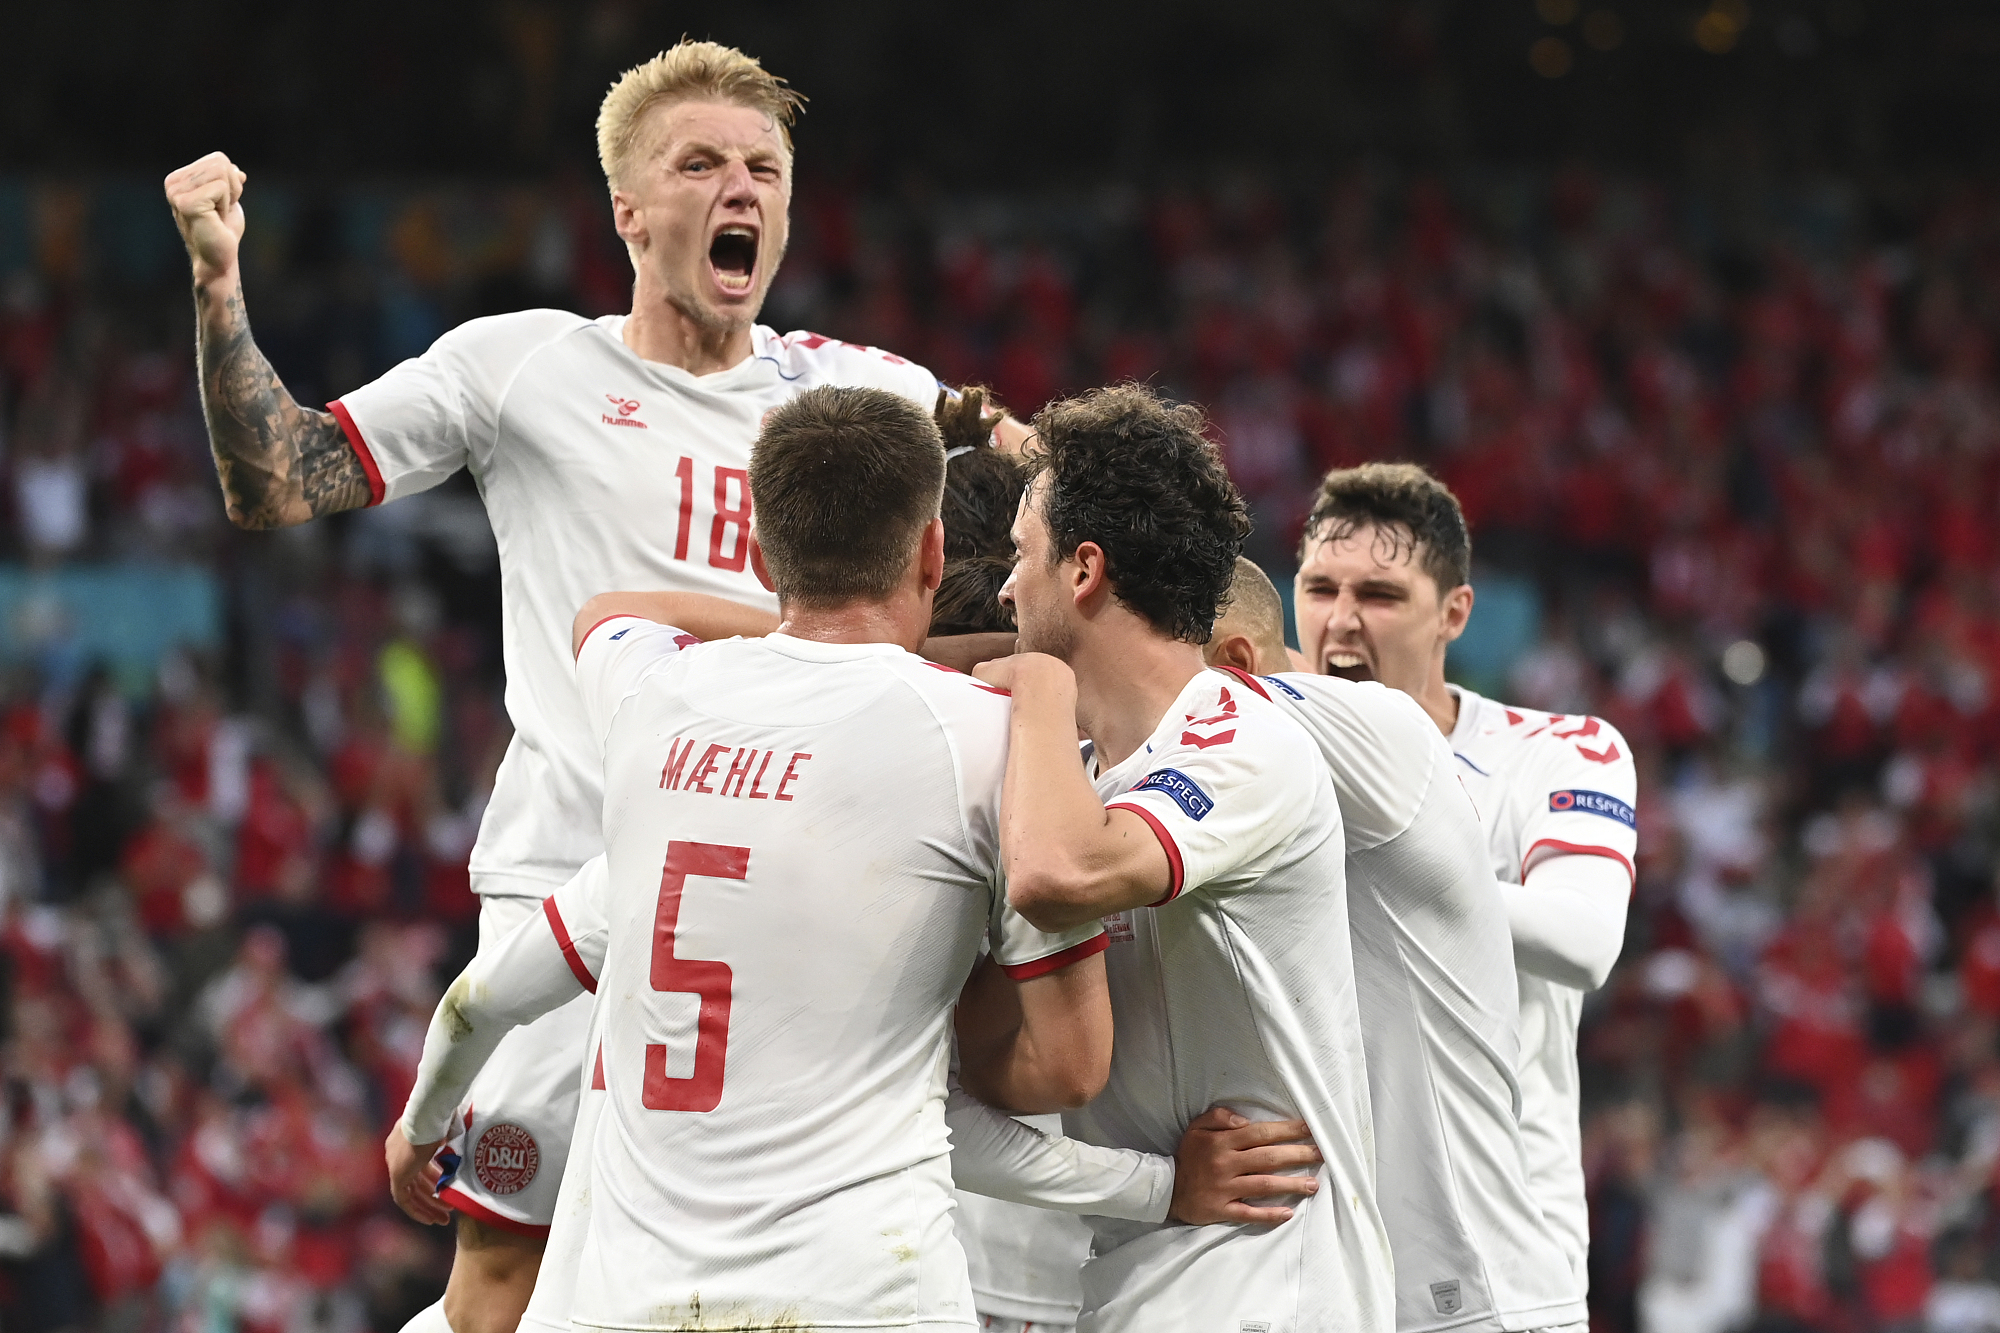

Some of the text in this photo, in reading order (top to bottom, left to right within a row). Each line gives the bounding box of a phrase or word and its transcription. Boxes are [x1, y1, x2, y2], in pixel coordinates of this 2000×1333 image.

[674, 456, 752, 573] 18
[659, 737, 813, 801] MÆHLE
[1146, 773, 1208, 815] RESPECT
[1576, 794, 1635, 823] RESPECT
[641, 840, 751, 1113] 5
[486, 1146, 525, 1169] DBU
